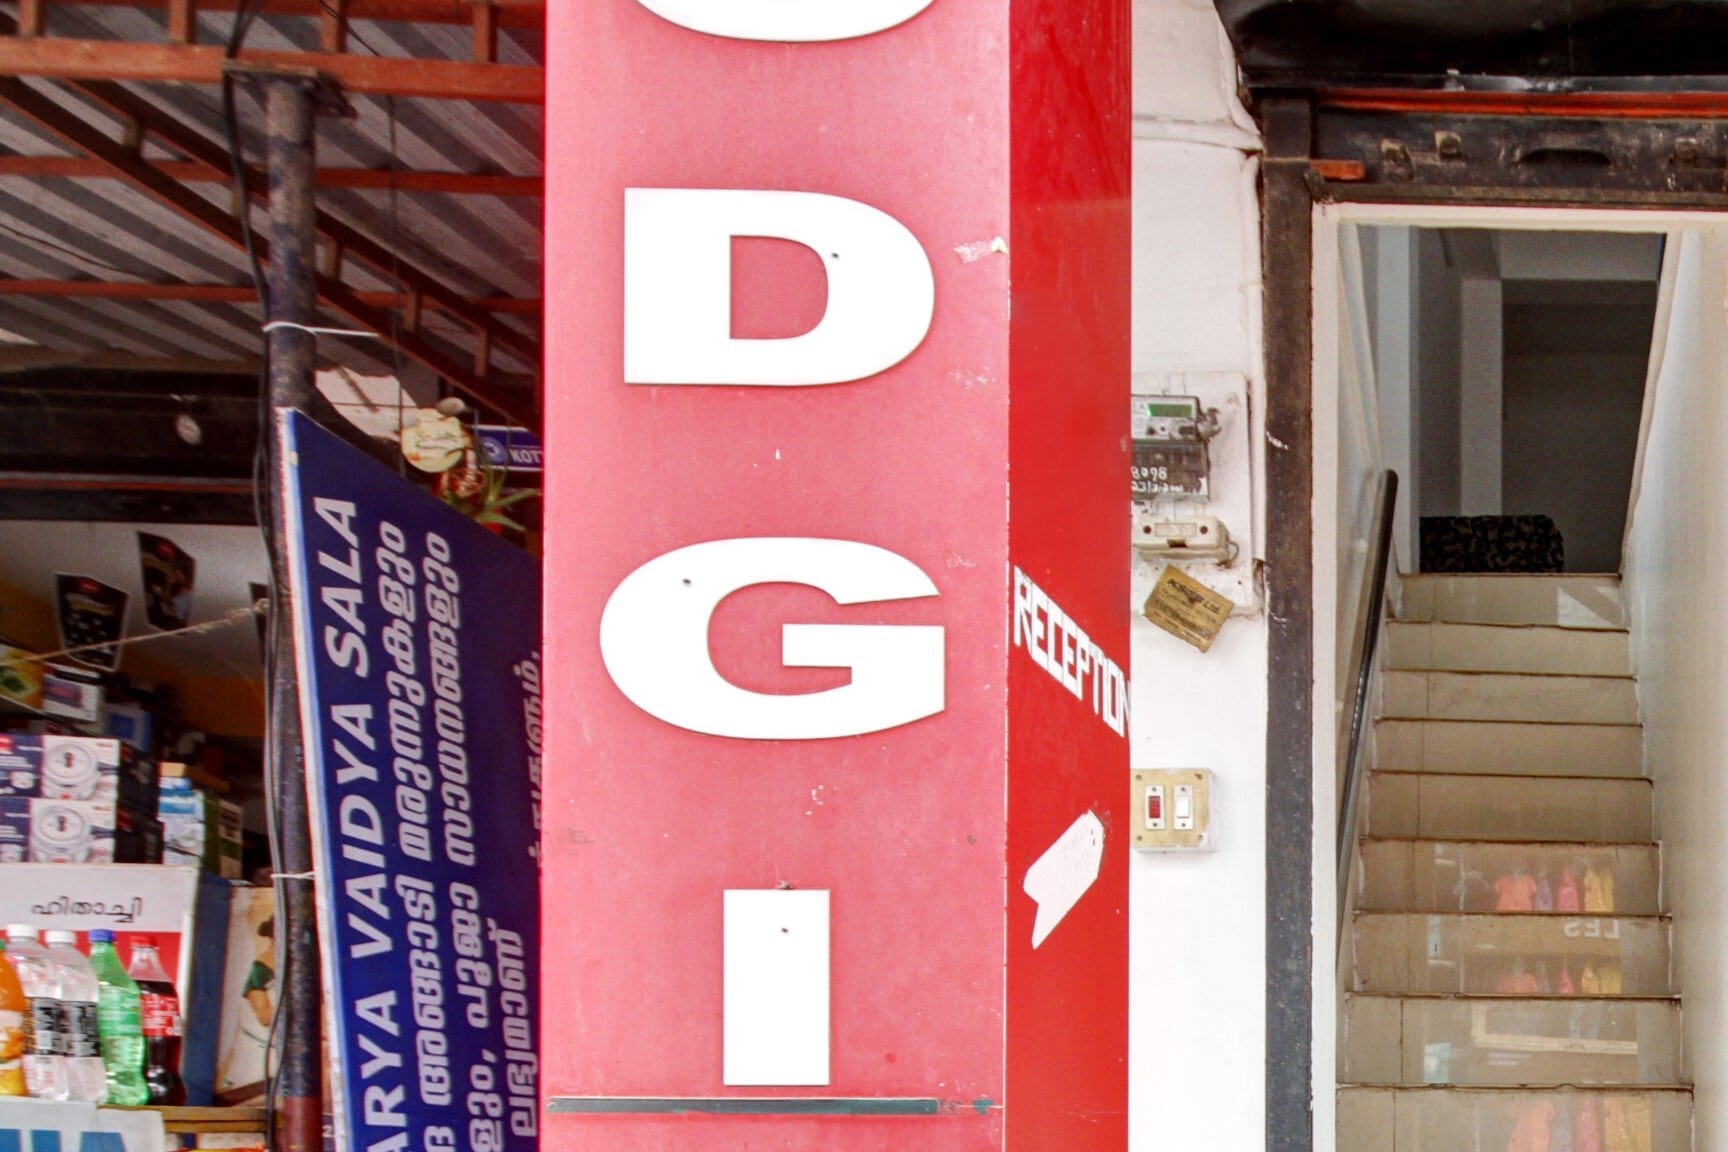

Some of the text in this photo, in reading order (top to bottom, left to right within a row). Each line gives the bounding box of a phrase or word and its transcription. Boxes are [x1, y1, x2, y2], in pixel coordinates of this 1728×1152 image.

[509, 448, 543, 464] KOT
[313, 496, 370, 678] SALA
[1014, 564, 1131, 738] RECEPTION
[330, 703, 395, 959] VAIDYA
